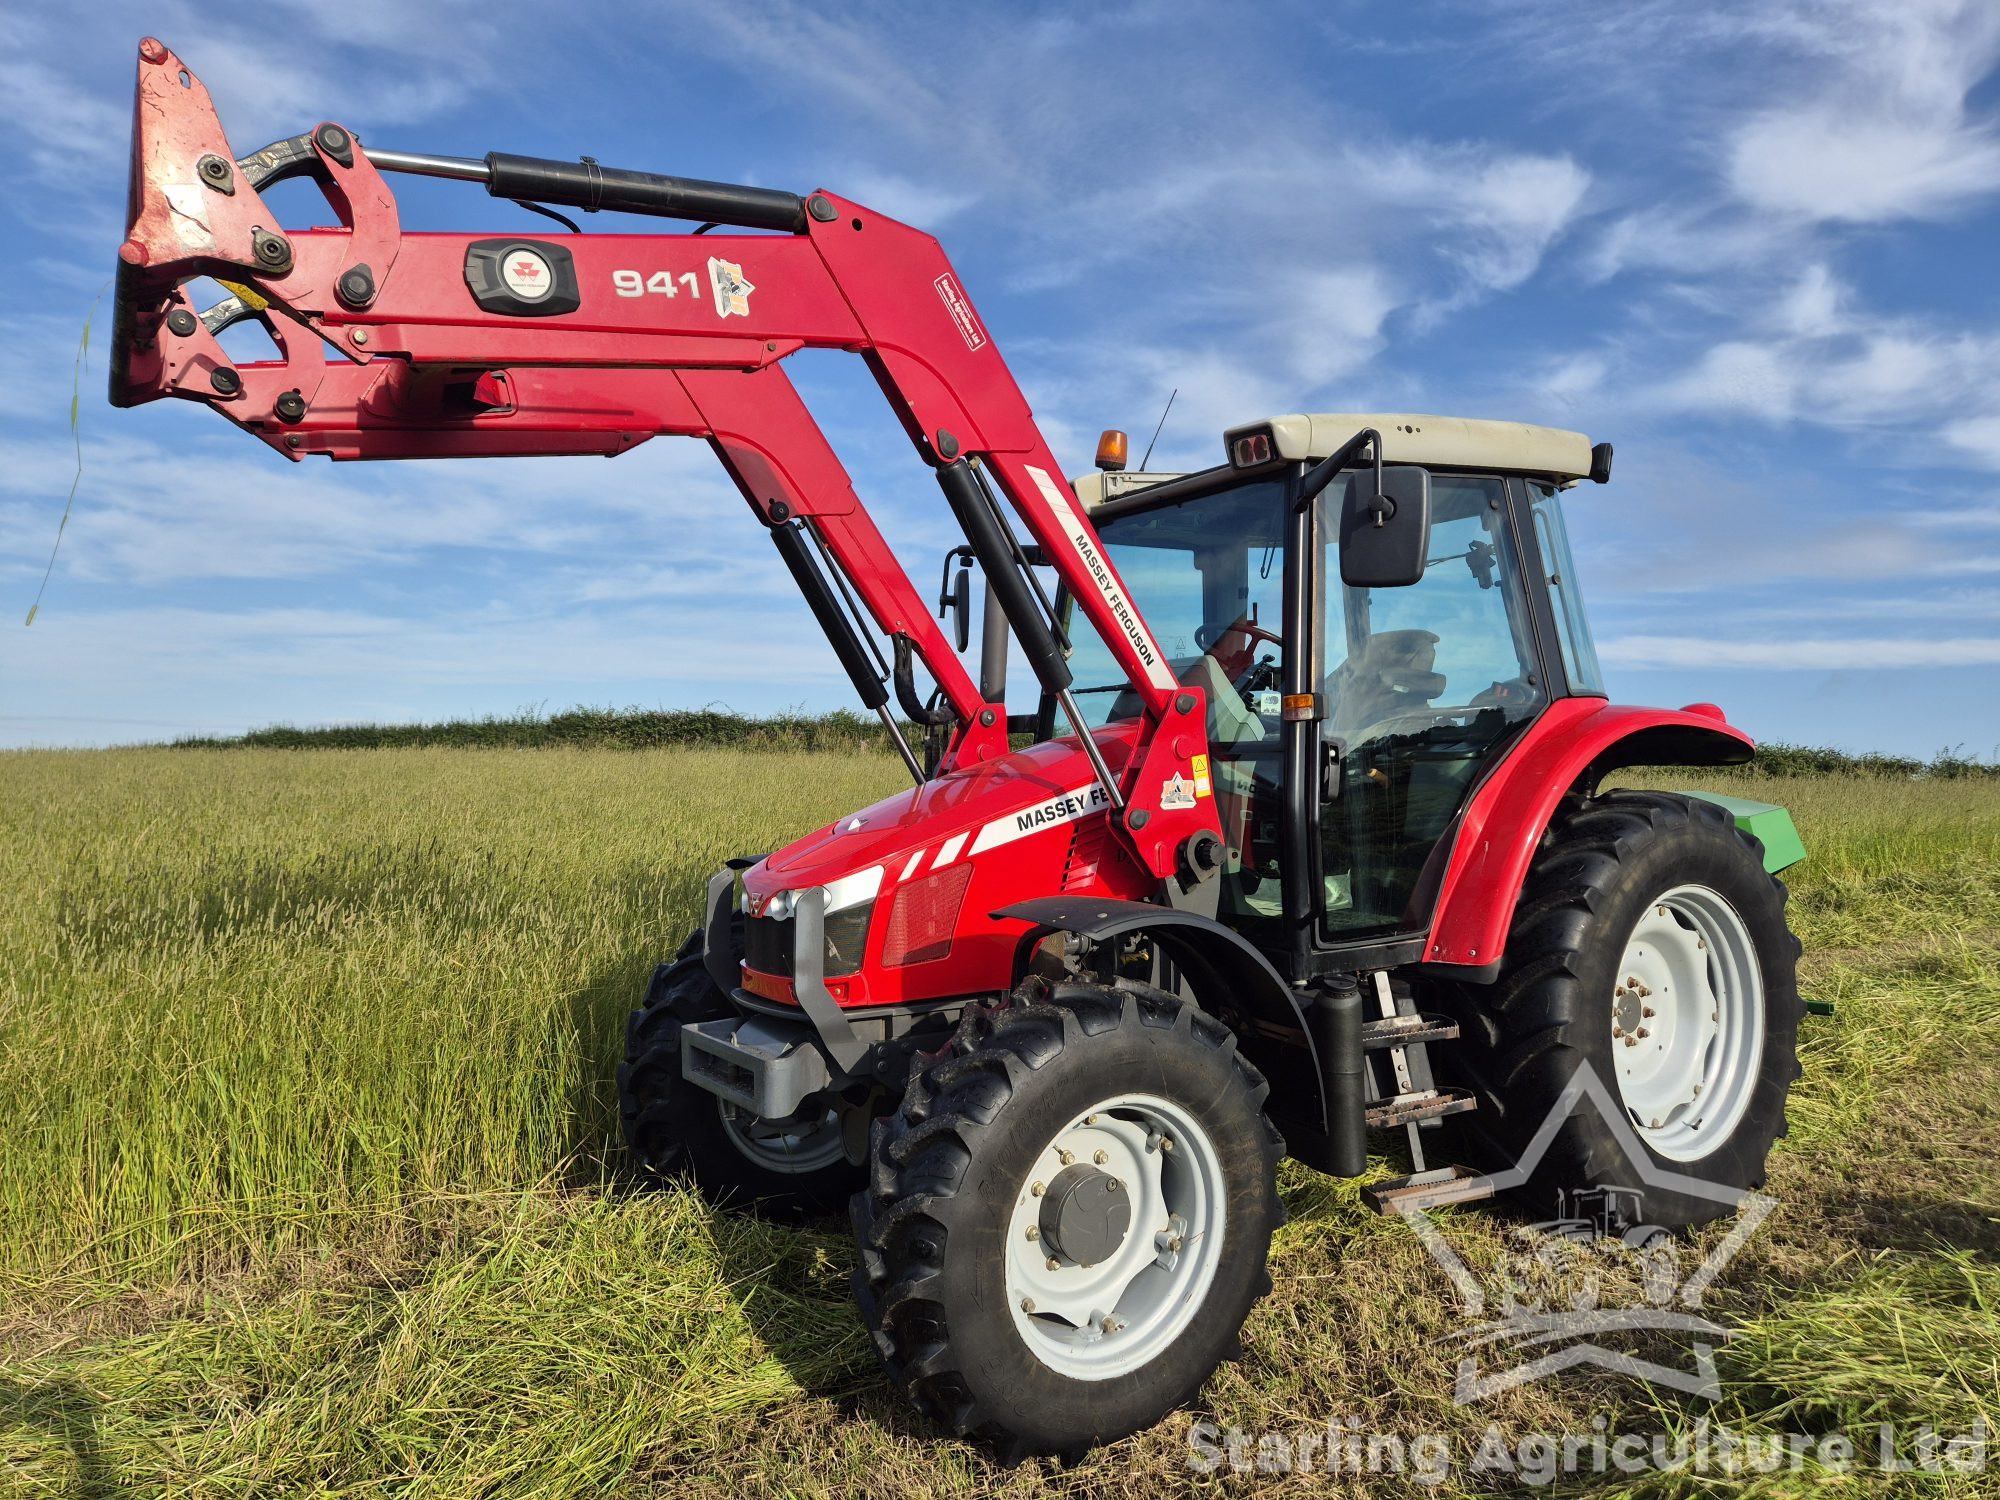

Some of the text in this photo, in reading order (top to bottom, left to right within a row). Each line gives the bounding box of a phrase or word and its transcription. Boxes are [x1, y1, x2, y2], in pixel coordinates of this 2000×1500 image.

[612, 269, 700, 299] 941
[1075, 534, 1155, 667] MASSEY FERGUSON
[1016, 794, 1086, 832] MASSEY
